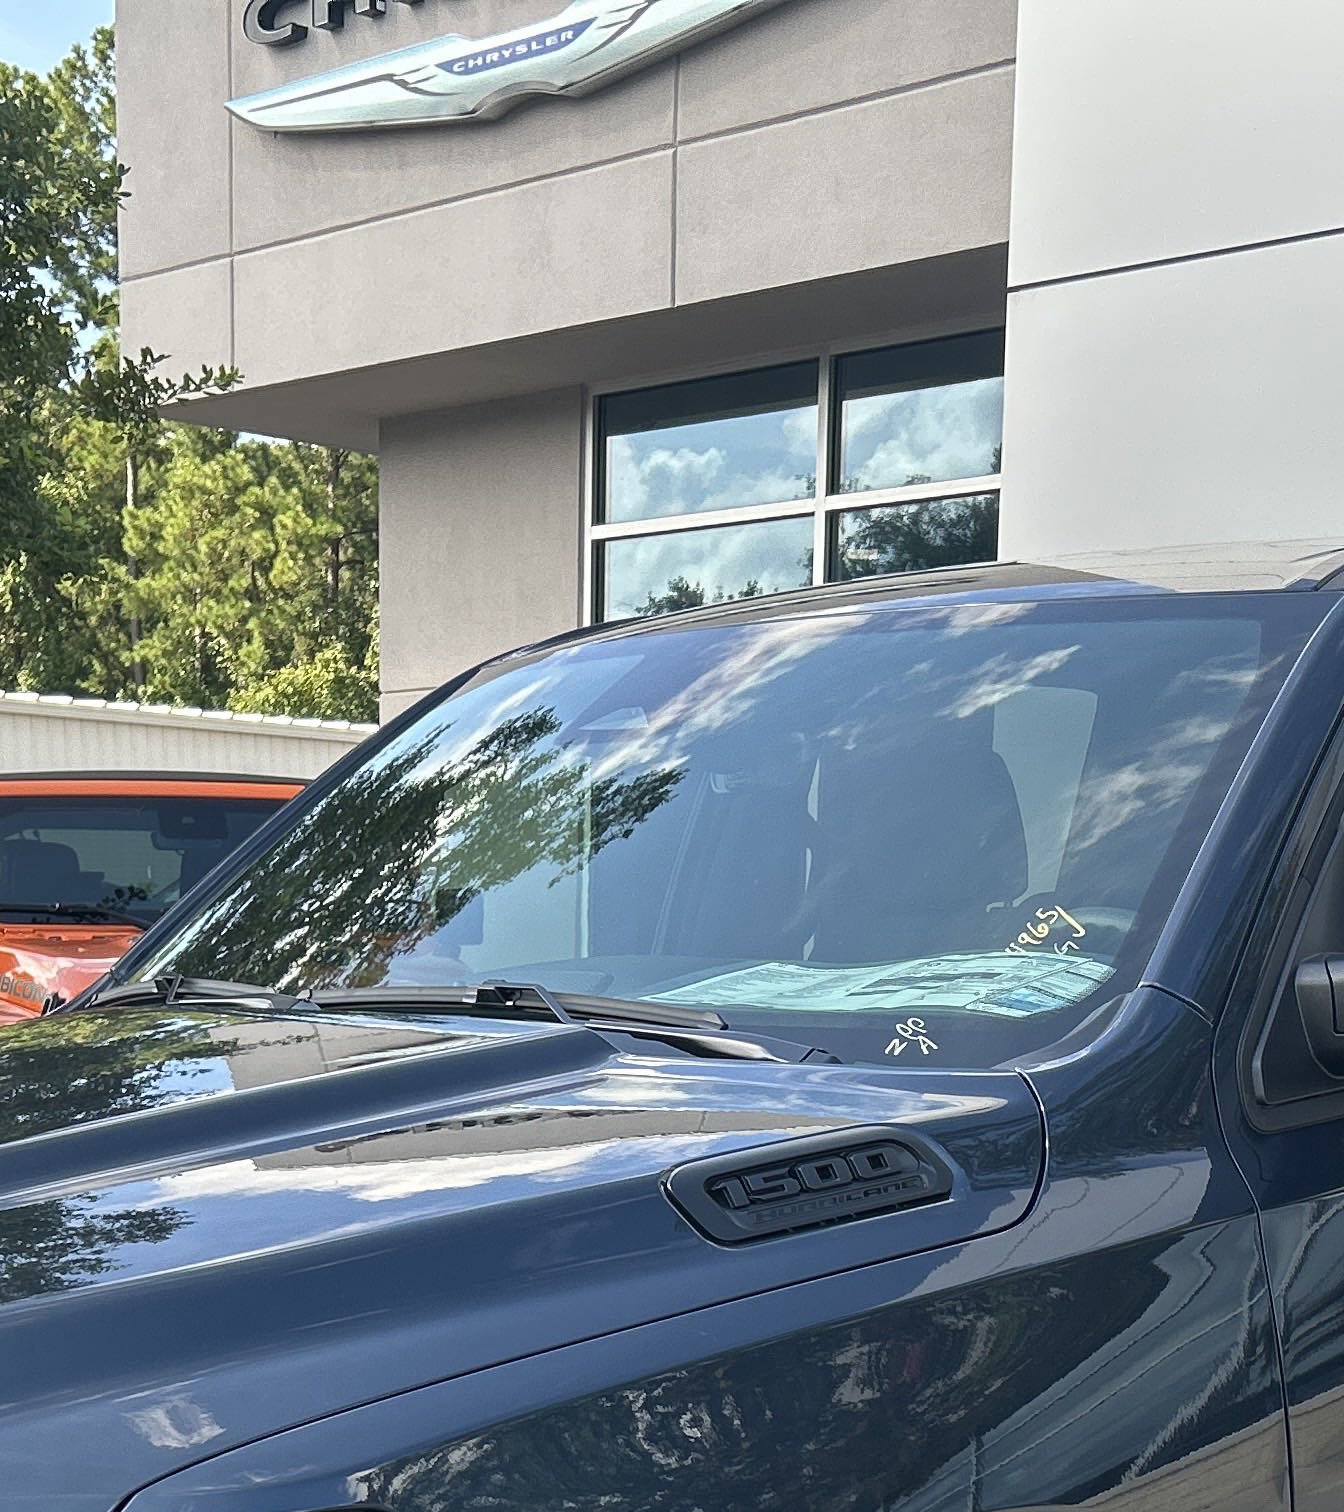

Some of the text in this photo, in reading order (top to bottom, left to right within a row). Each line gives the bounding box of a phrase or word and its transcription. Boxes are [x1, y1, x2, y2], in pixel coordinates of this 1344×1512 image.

[452, 30, 576, 73] CHRYSLER
[711, 1150, 904, 1210] 1500
[755, 1177, 926, 1224] HURRICANE
